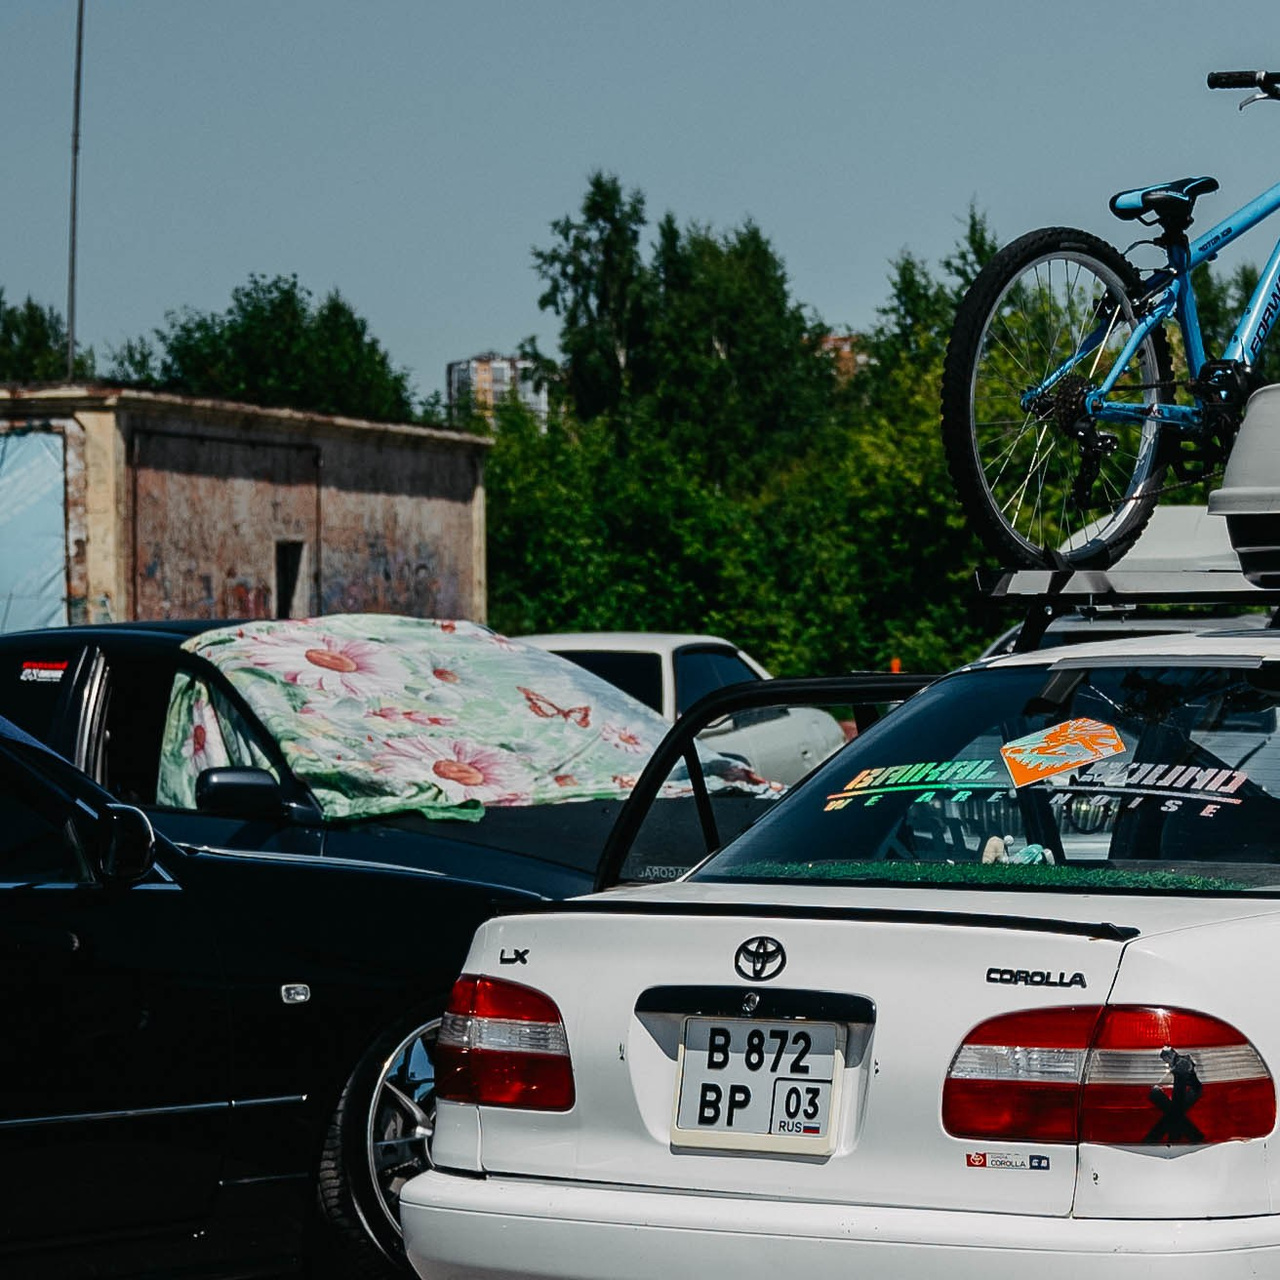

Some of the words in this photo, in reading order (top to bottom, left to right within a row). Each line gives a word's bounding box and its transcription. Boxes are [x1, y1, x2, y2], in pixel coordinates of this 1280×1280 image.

[844, 759, 998, 790] BAIKAL
[1079, 761, 1249, 793] SOUND
[823, 794, 882, 812] WE
[915, 789, 1006, 804] ARE
[1048, 792, 1220, 818] NOISE
[499, 948, 530, 965] LX
[986, 968, 1087, 988] COROLLA
[744, 1028, 812, 1074] 872
[784, 1086, 821, 1120] 03
[778, 1120, 802, 1133] RUS
[990, 1159, 1026, 1168] COROLLA
